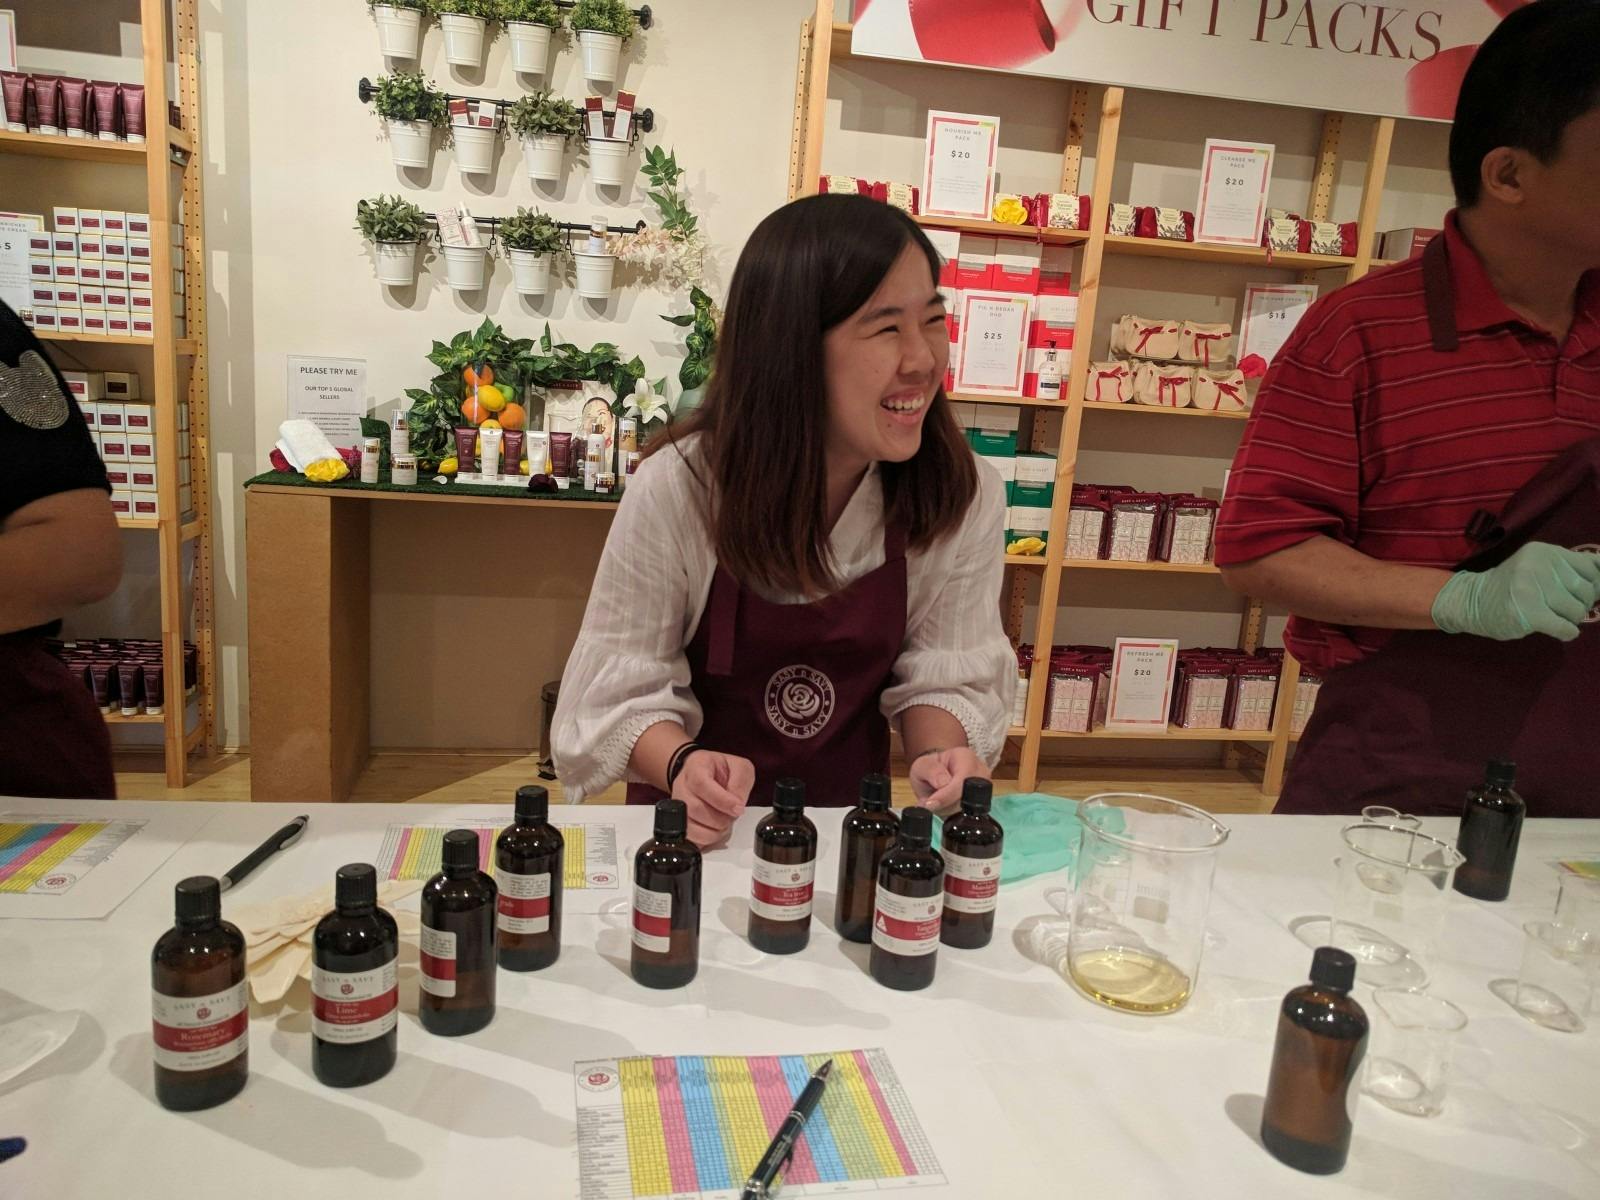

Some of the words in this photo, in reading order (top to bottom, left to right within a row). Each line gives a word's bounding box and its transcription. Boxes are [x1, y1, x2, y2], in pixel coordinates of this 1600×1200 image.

[1250, 0, 1442, 62] PACKS
[951, 150, 970, 158] $20
[1225, 178, 1244, 186] $20
[300, 366, 328, 374] PLEASE
[336, 1006, 358, 1014] Lime
